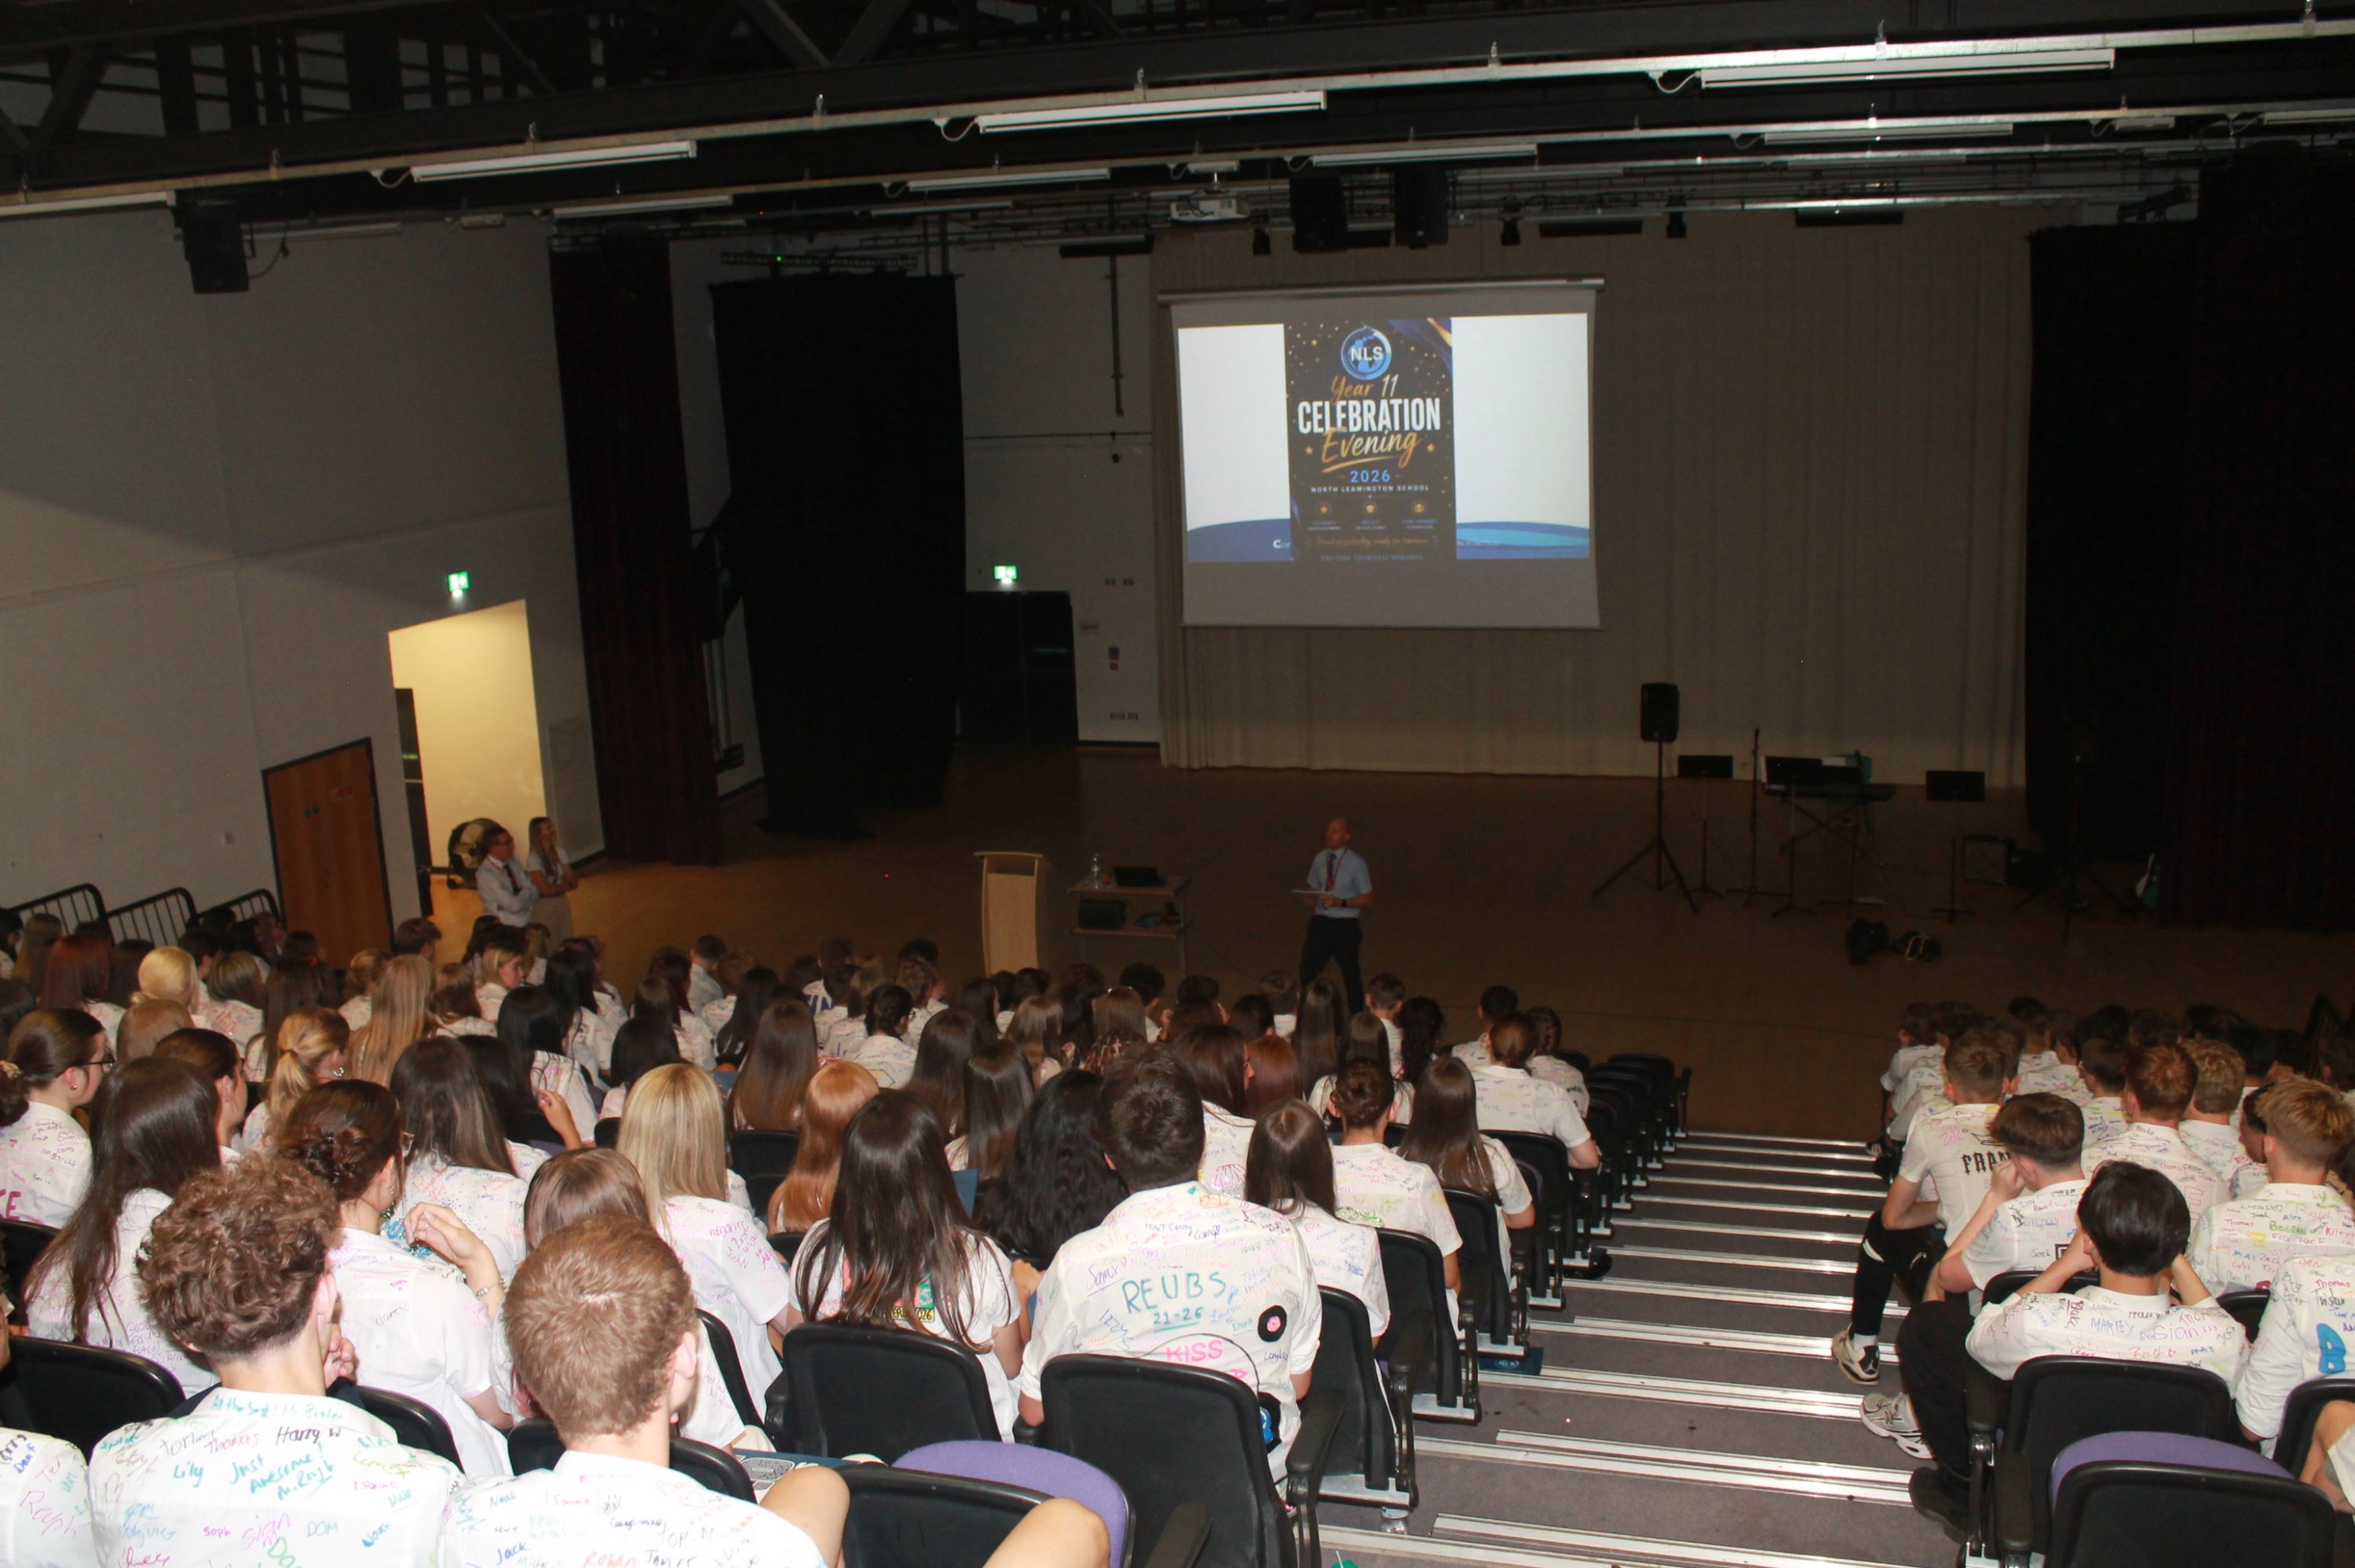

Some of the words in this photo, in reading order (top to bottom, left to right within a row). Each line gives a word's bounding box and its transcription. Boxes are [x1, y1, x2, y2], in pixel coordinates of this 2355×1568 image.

[1350, 345, 1384, 362] NLS
[1331, 375, 1374, 404] Year
[1381, 374, 1399, 397] 11
[1297, 397, 1441, 434] CELEBRATION
[1321, 427, 1421, 469] Evening
[1350, 470, 1391, 484] 2026
[1121, 1271, 1227, 1314] REUBS
[1153, 1306, 1205, 1326] 21-26
[1165, 1339, 1224, 1363] KISS
[203, 1433, 260, 1454] Thomas
[276, 1426, 320, 1446] Harry
[172, 1460, 205, 1489] Lily
[307, 1520, 339, 1537] DOM
[496, 1541, 527, 1566] Jack
